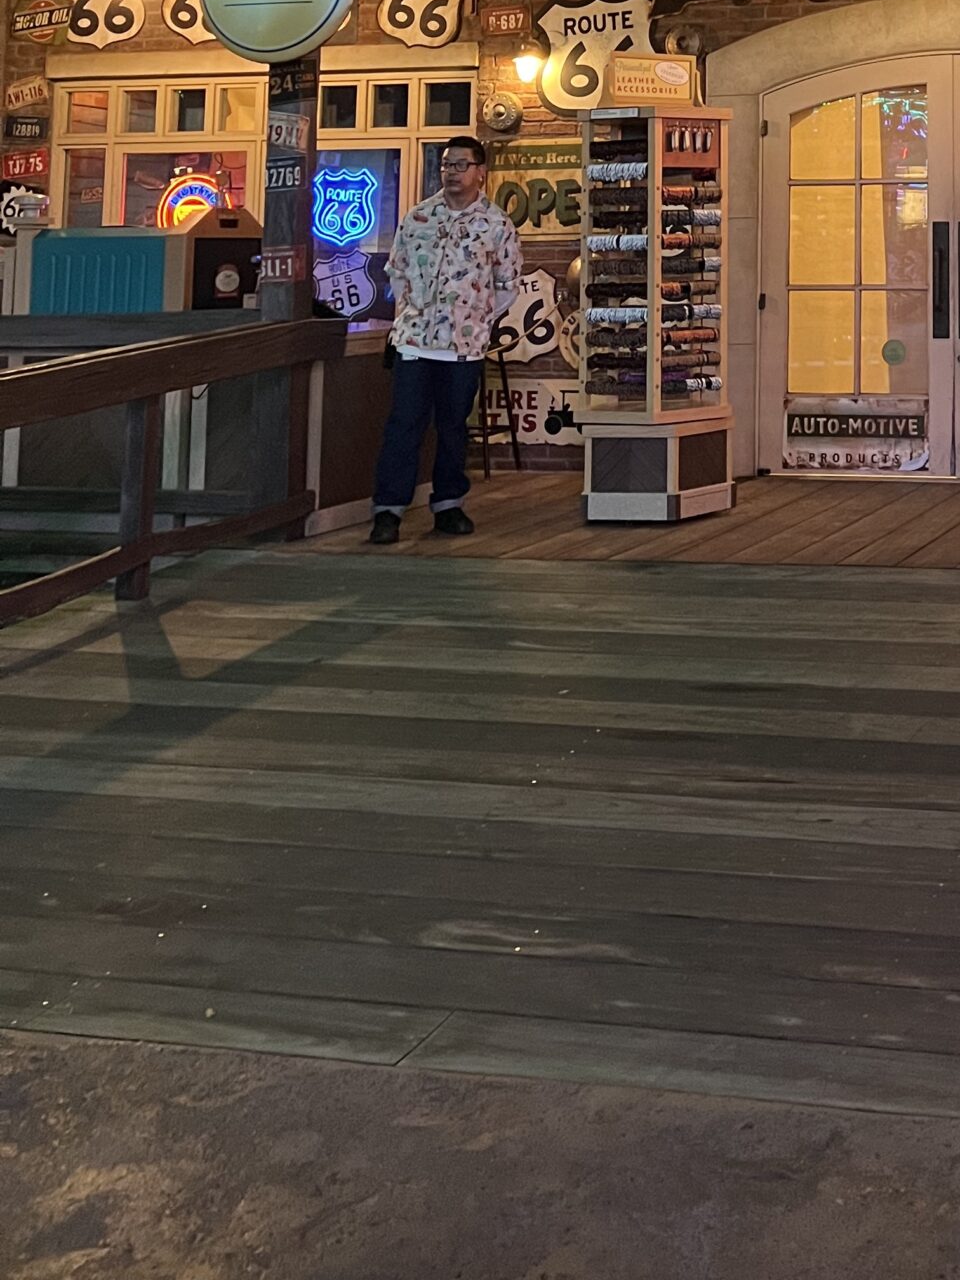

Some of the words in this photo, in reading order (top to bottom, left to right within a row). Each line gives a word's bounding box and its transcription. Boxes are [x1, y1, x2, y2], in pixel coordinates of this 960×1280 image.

[51, 7, 68, 24] OIL
[563, 9, 635, 37] ROUTE
[616, 76, 656, 85] LEATHER
[616, 85, 678, 95] ACCESSORIES
[326, 187, 363, 203] ROUTE
[495, 177, 582, 229] OPE
[324, 201, 364, 232] 66
[331, 284, 361, 311] 66
[790, 416, 919, 436] AUTO-MOTIVE
[808, 452, 900, 465] PRODUCTS
